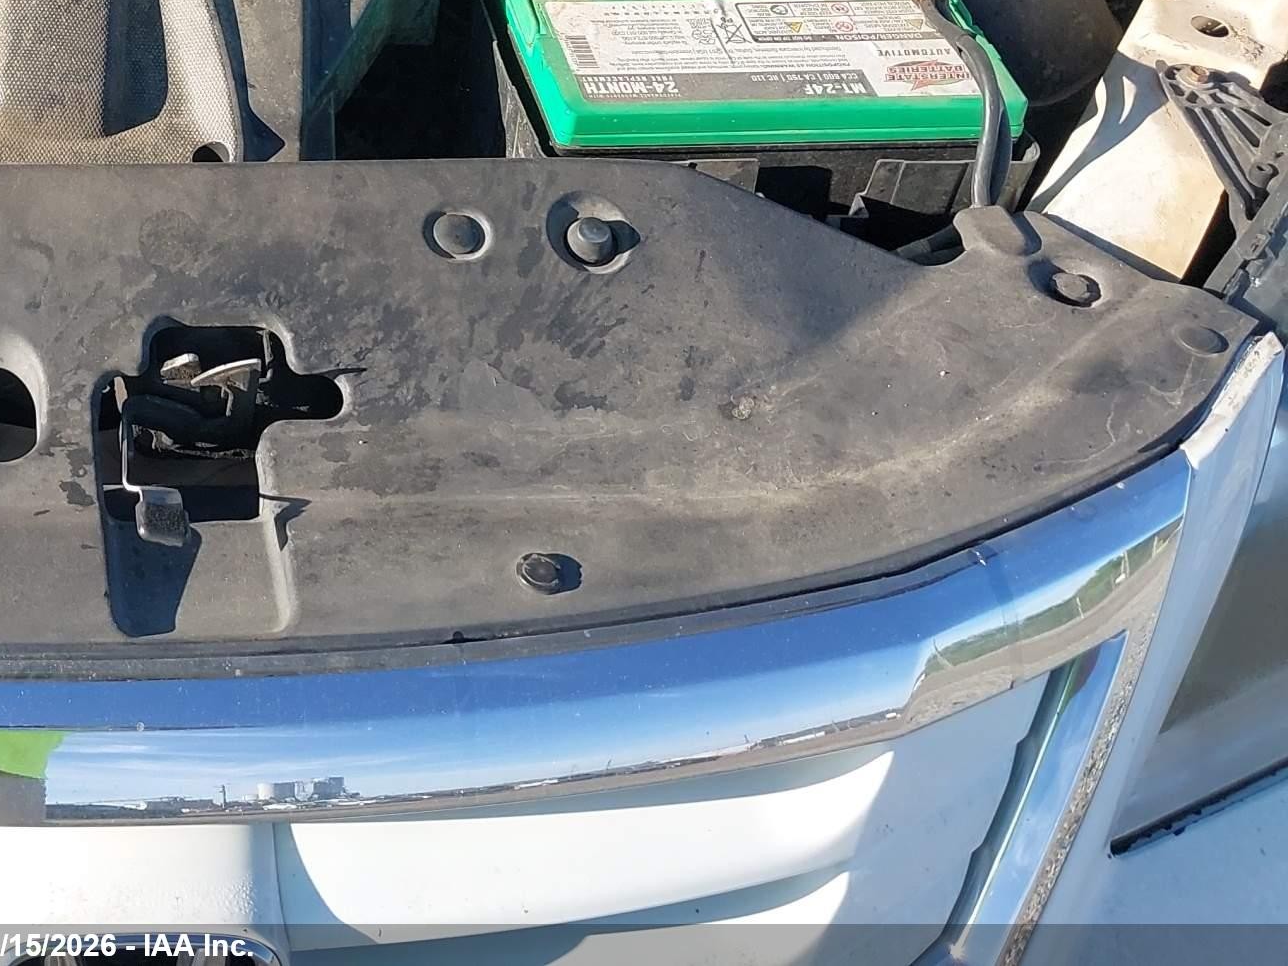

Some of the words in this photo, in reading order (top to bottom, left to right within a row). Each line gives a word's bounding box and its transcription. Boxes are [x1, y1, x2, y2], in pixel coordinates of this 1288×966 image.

[835, 32, 922, 40] DANGER/POISON
[876, 48, 950, 57] AUTOMOTIVE
[887, 65, 964, 74] BATTERIES
[803, 73, 816, 81] CA
[841, 72, 858, 80] CCA
[884, 73, 970, 82] INTERSTATE
[583, 81, 679, 94] 24-MONTH
[804, 82, 867, 95] MT-24F
